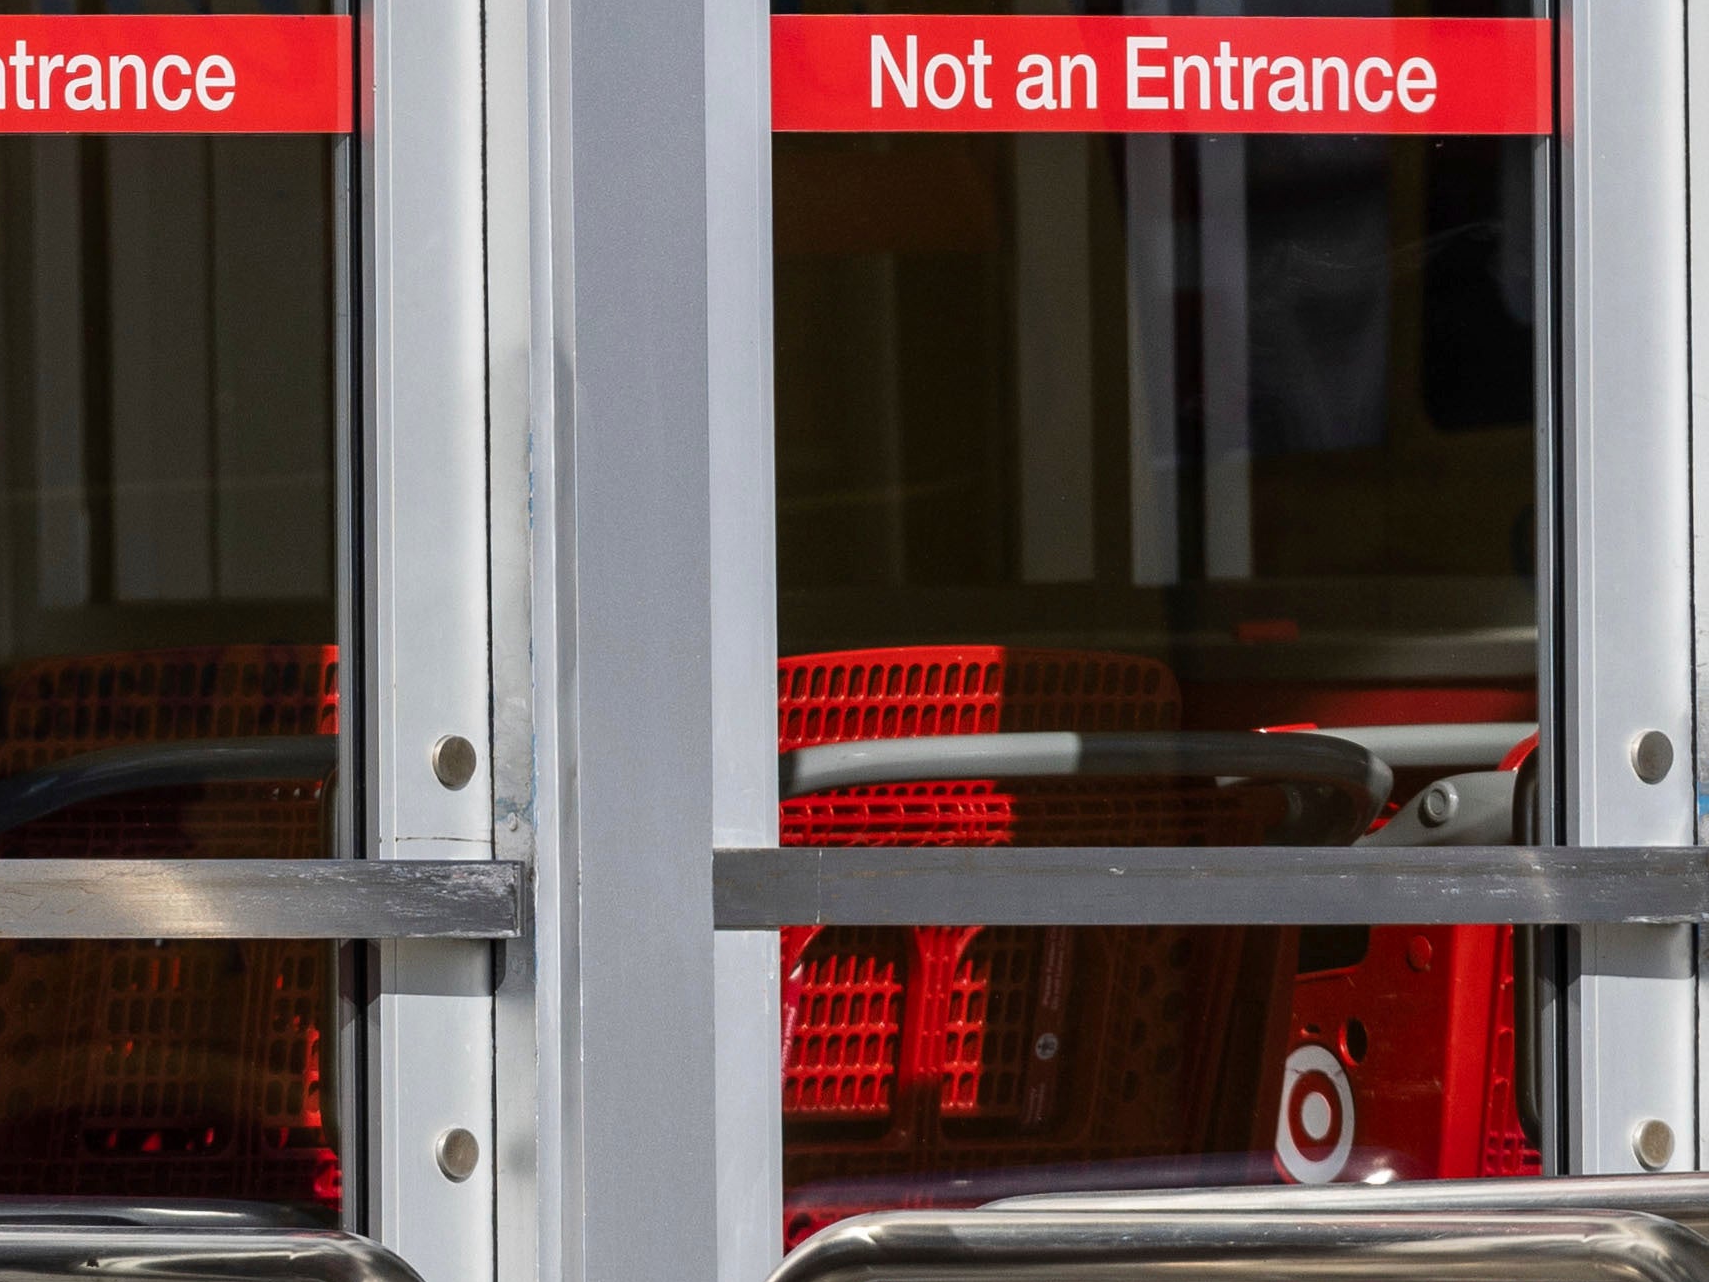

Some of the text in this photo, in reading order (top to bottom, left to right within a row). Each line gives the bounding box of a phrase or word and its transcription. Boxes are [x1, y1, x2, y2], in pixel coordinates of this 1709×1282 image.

[869, 35, 1437, 113] Not an Entrance
